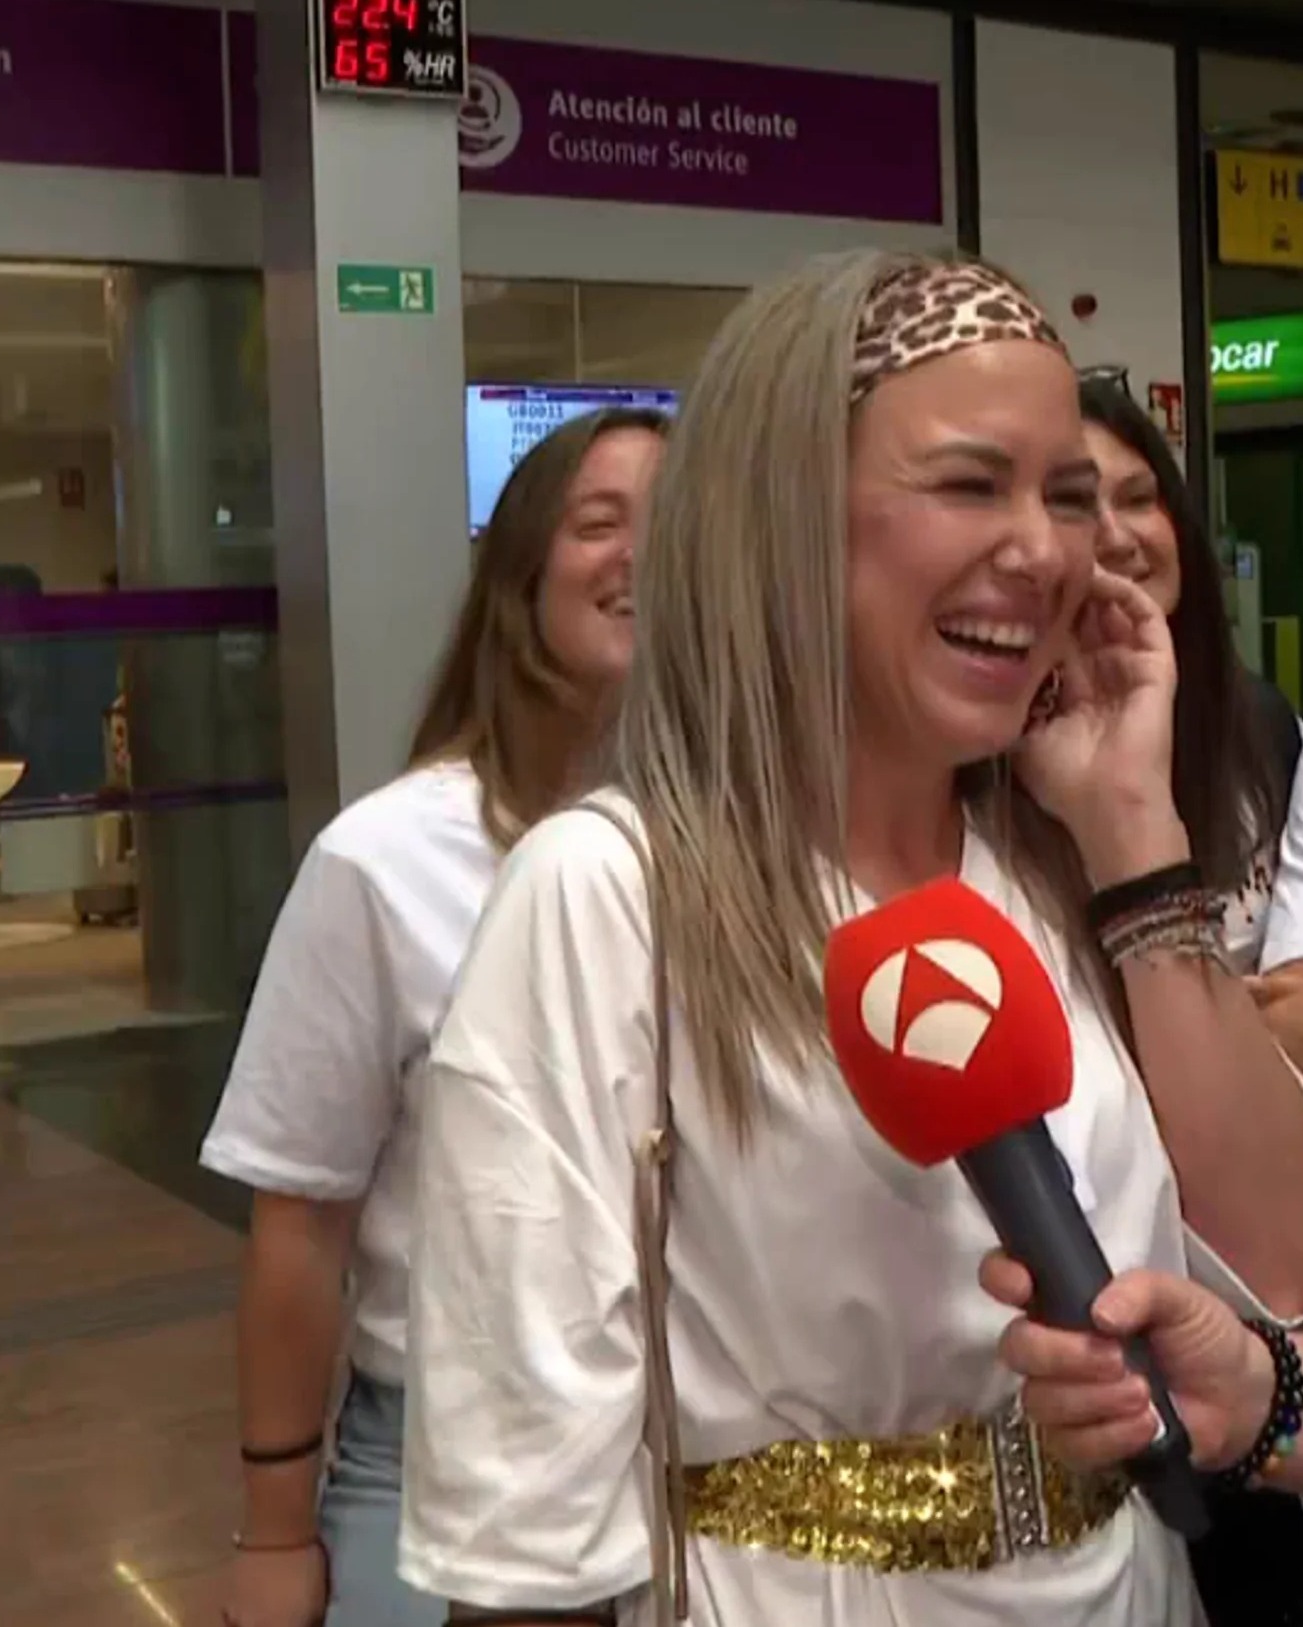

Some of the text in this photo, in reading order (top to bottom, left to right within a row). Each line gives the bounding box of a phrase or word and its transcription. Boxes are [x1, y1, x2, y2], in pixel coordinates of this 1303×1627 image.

[335, 40, 387, 80] 65
[549, 89, 797, 138] Atención al cliente
[549, 131, 748, 175] Customer Service
